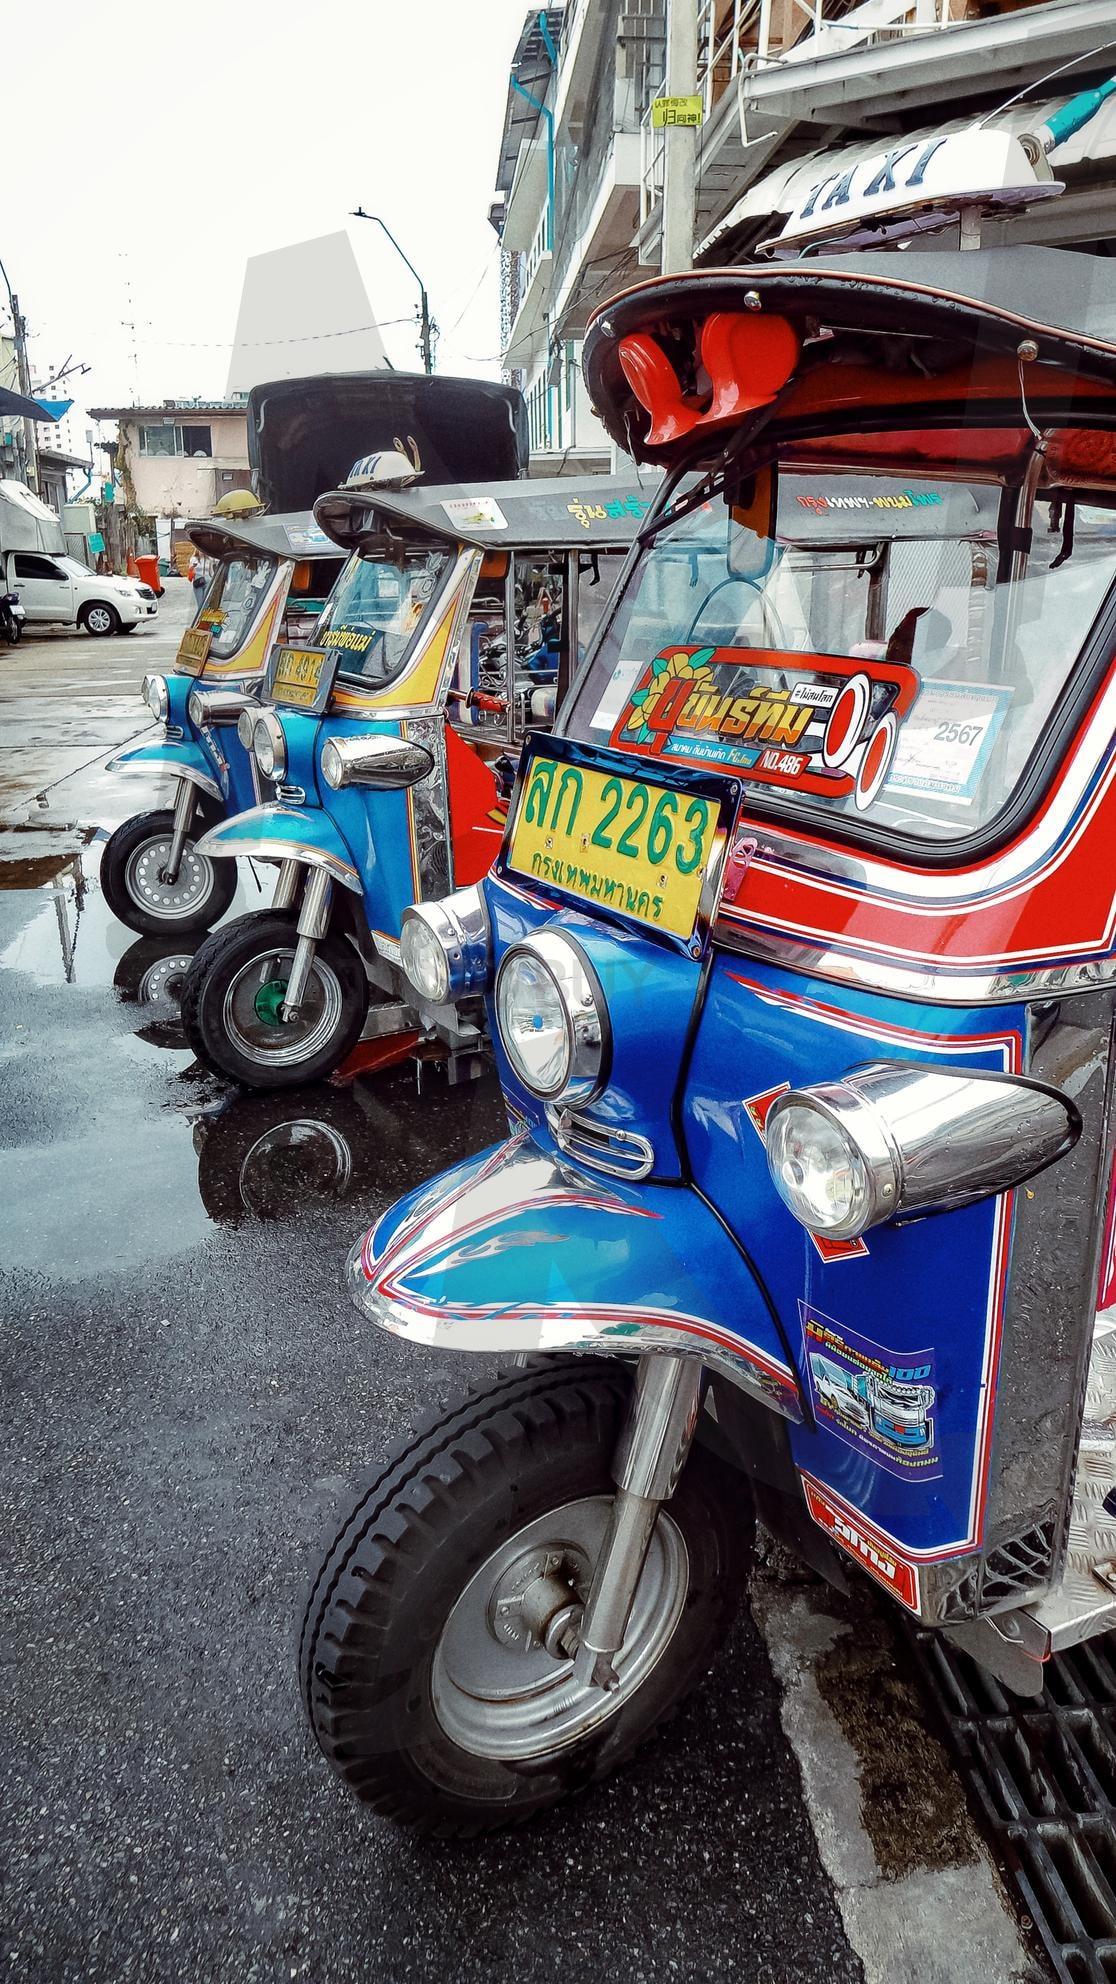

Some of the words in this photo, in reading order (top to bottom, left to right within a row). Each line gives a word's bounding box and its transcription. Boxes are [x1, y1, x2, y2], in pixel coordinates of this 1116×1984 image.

[799, 138, 948, 219] TAXI
[760, 750, 803, 775] NO.486
[933, 721, 984, 747] 2567
[592, 776, 710, 875] 2263
[531, 851, 665, 922] กรุงเทพมหานคร
